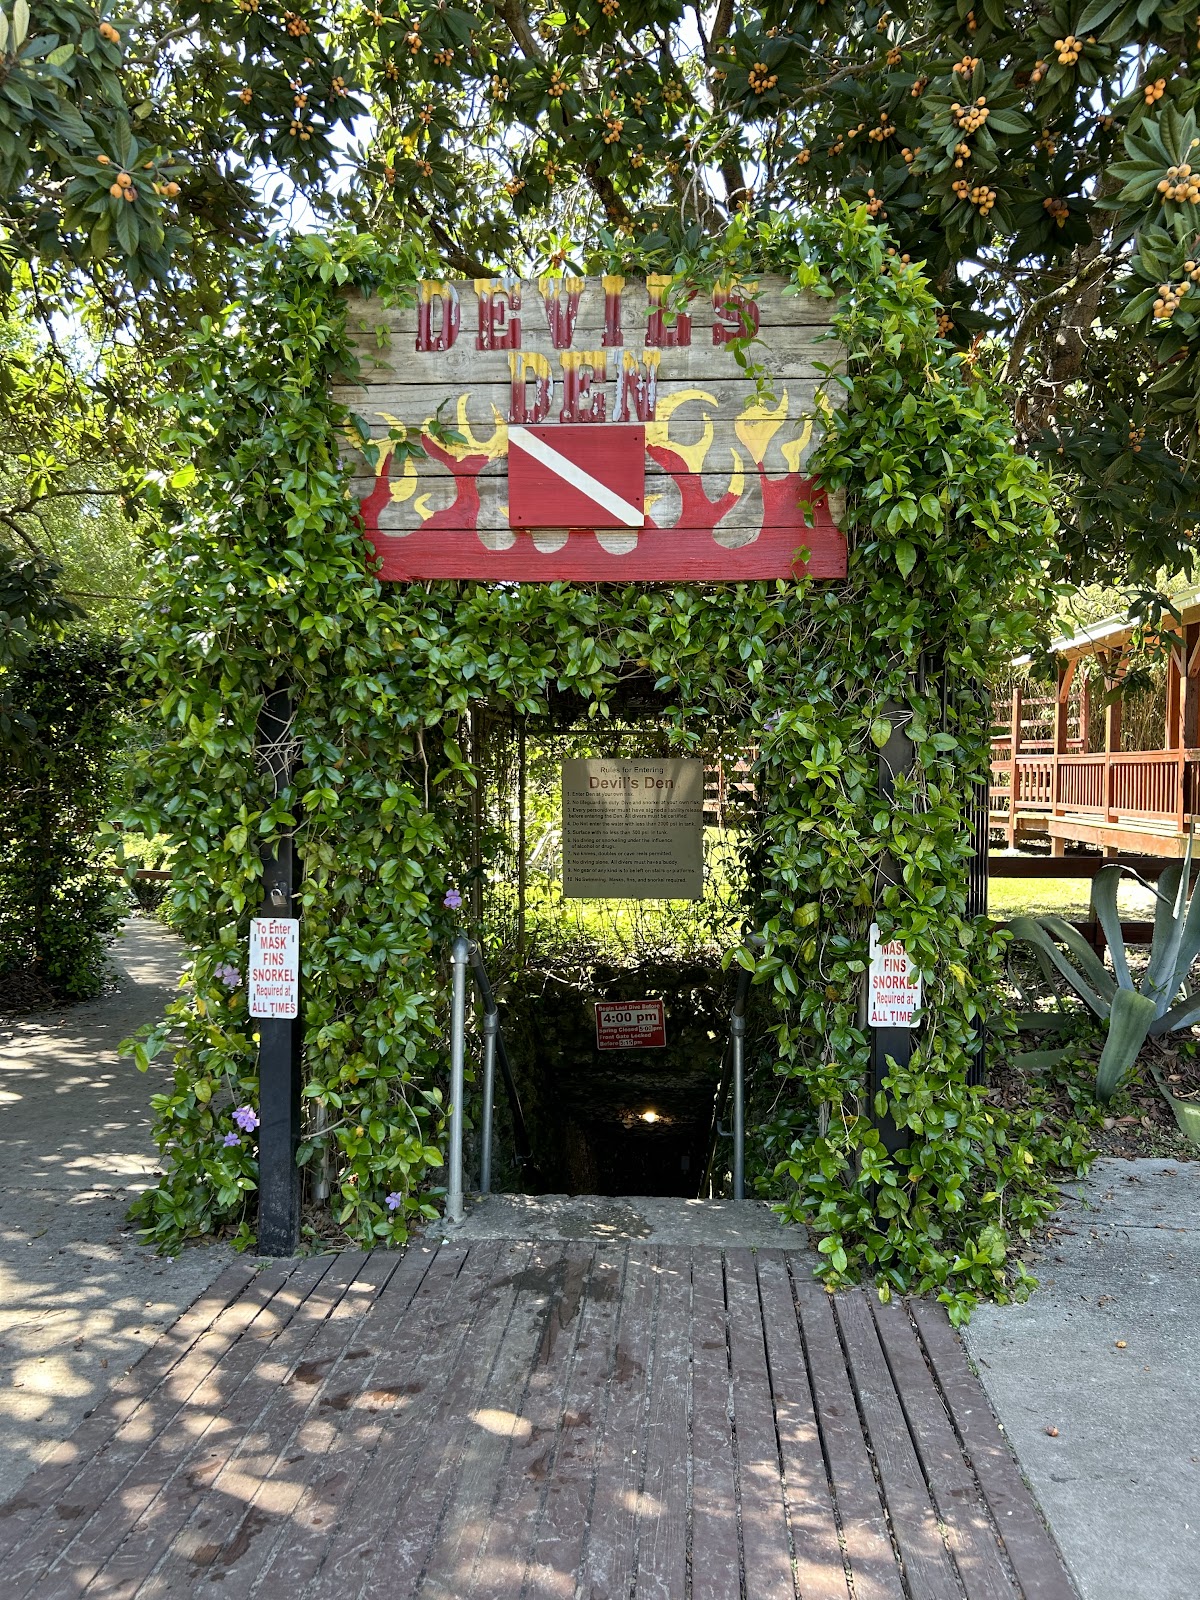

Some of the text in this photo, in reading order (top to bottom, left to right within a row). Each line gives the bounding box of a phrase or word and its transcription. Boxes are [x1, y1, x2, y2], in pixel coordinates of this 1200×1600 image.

[508, 350, 660, 423] DEN
[590, 776, 674, 788] Devil's Den
[257, 923, 291, 934] To Enter
[260, 937, 286, 949] MASK
[882, 941, 907, 955] MAS
[263, 953, 284, 965] FINS
[884, 959, 906, 972] FINS
[253, 969, 294, 982] SNORKEL
[256, 984, 290, 998] Required at
[877, 992, 913, 1006] Required at
[252, 1003, 296, 1013] ALL TIMES
[604, 1013, 656, 1023] 4:00 pm
[872, 1011, 912, 1021] ALL TIME
